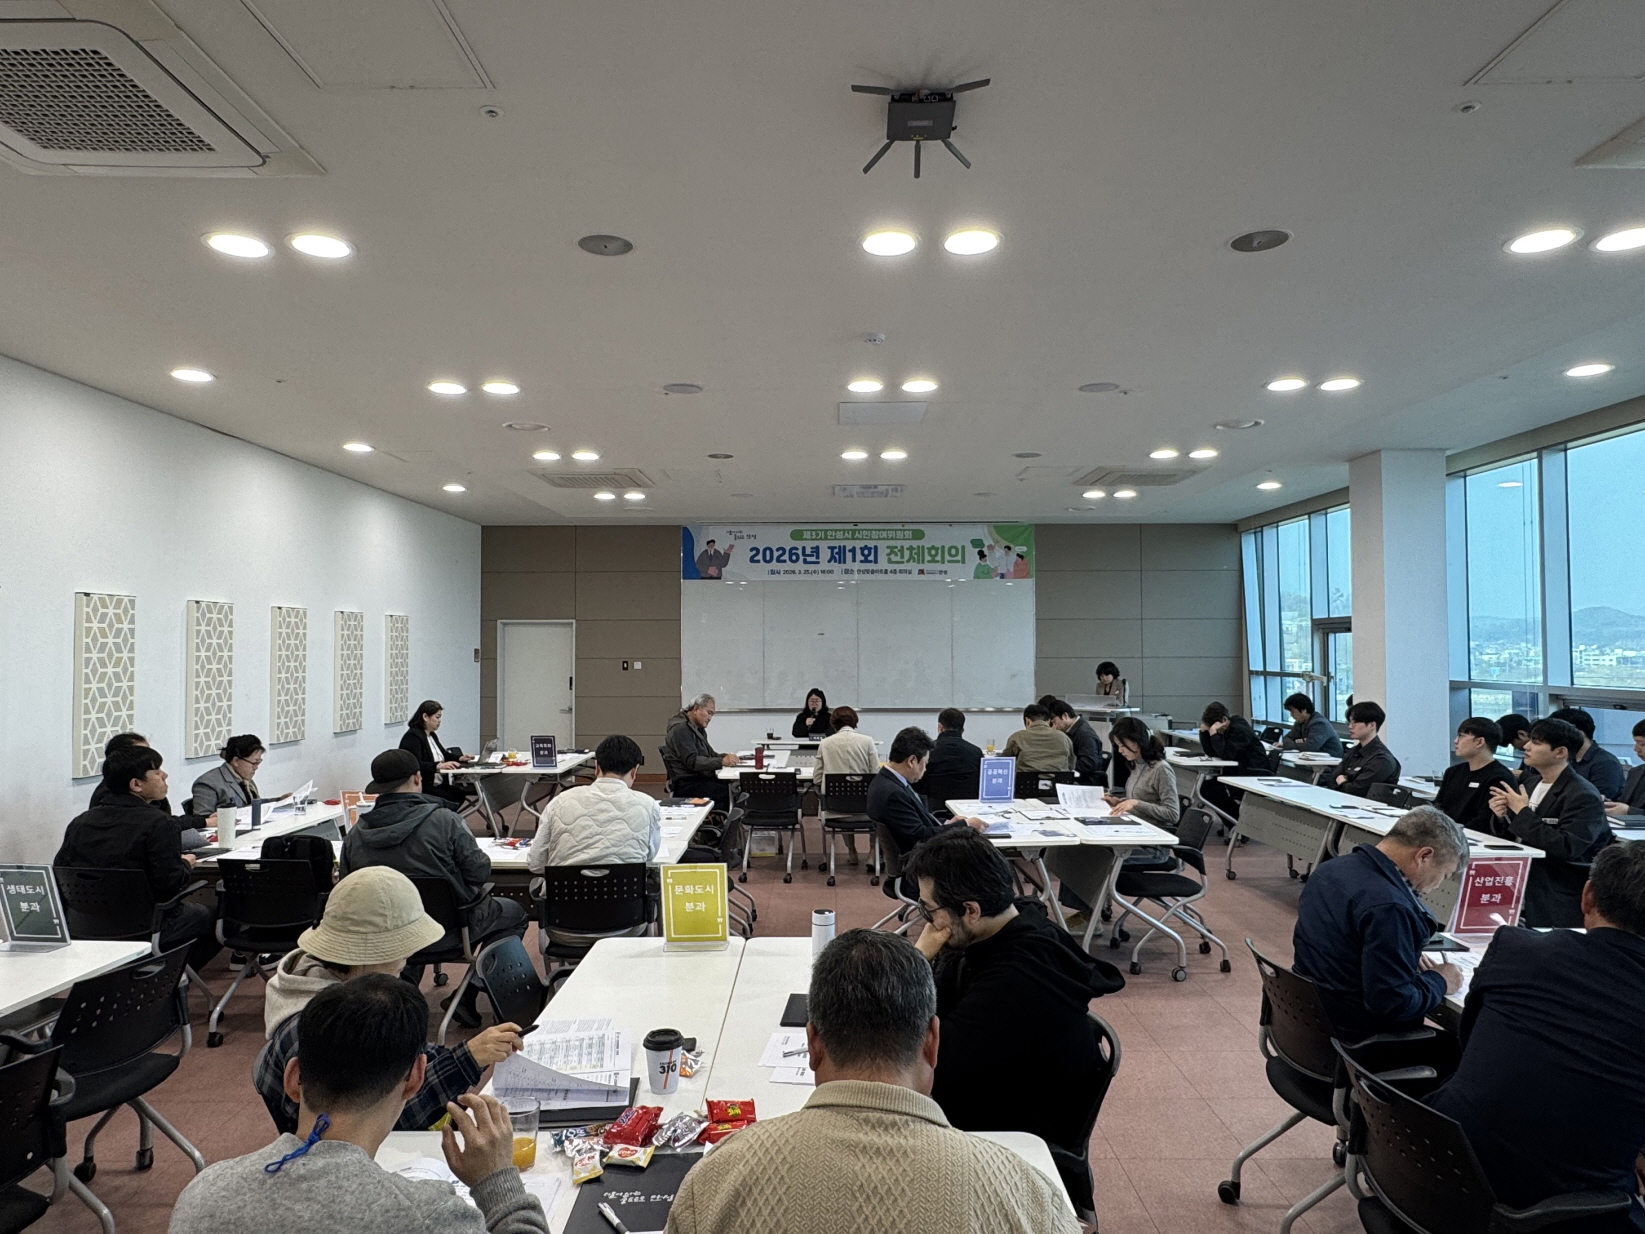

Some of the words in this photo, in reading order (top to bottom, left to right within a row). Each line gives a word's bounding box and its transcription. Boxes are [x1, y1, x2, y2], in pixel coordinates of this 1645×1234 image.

[802, 530, 824, 539] 제3기
[827, 530, 852, 539] 안성시
[854, 530, 913, 539] 시민참여위원회
[749, 545, 820, 564] 2026년
[827, 545, 879, 564] 제1회
[886, 545, 966, 564] 전체회의
[1474, 876, 1514, 887] 산업진흥
[6, 884, 45, 895] 생태도시
[674, 884, 714, 895] 문화도시
[1480, 893, 1502, 904] 분과
[19, 901, 41, 913] 분과
[684, 901, 706, 912] 분과
[659, 1063, 677, 1074] 310
